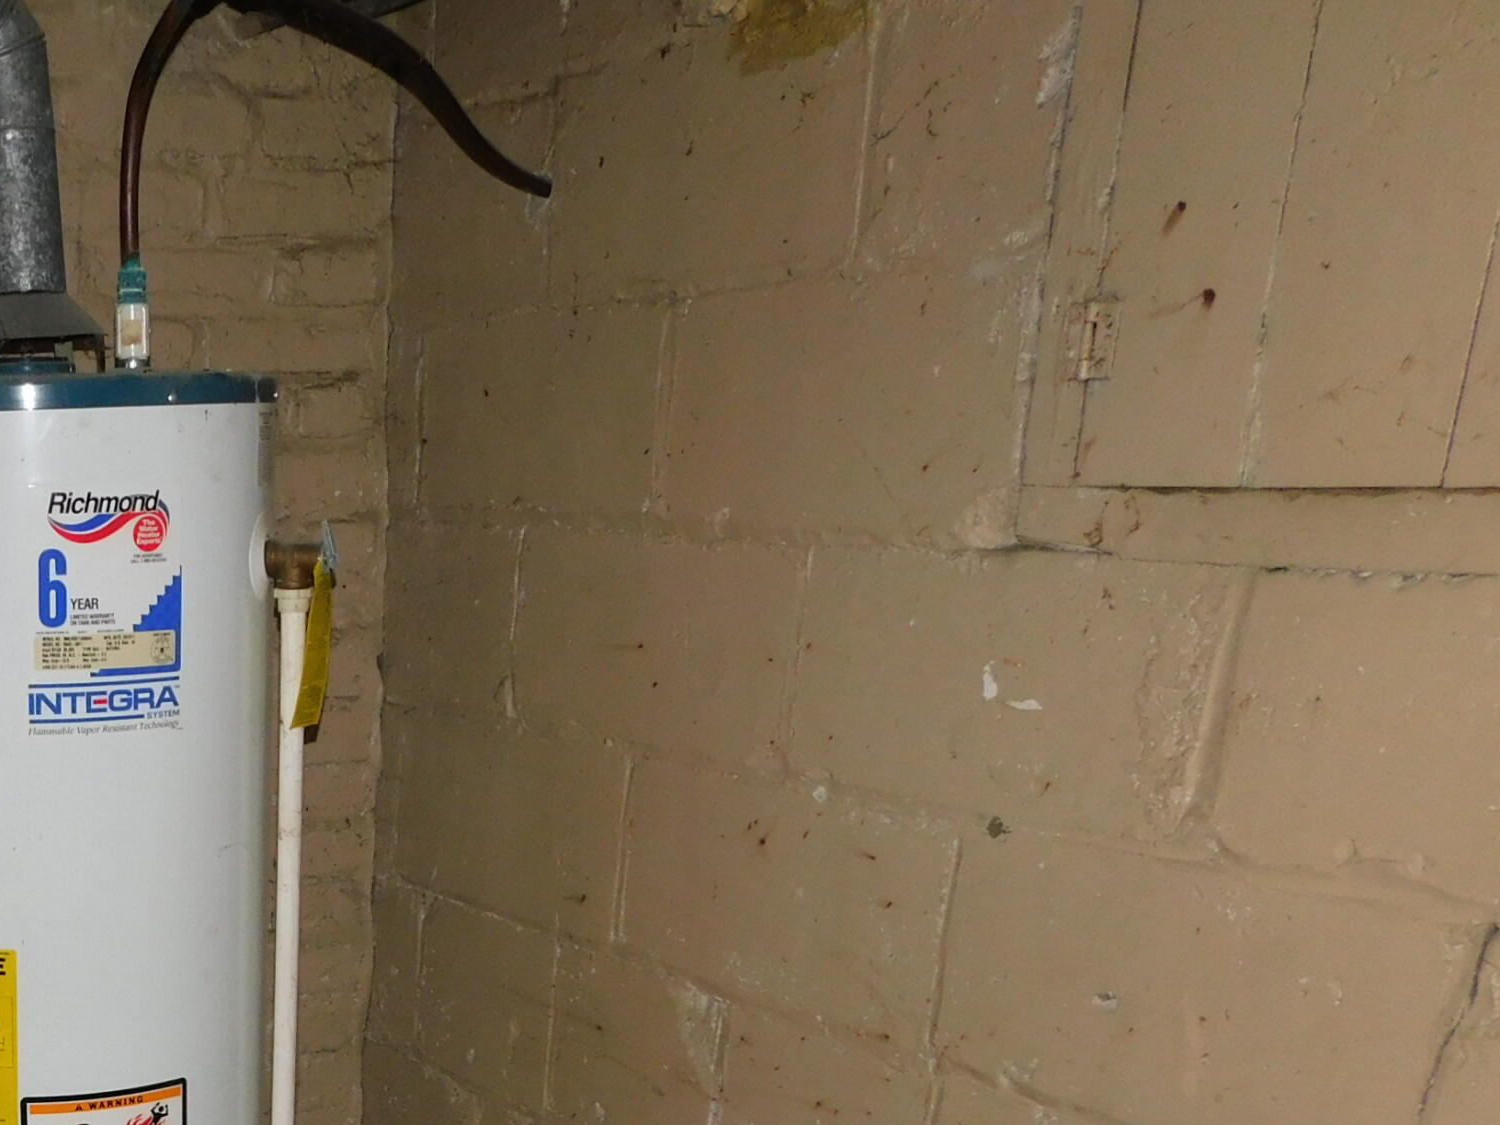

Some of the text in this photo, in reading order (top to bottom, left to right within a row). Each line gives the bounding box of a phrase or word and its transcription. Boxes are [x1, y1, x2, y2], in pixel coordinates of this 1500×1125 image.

[48, 490, 160, 514] Richmond
[38, 548, 68, 628] 6
[70, 598, 100, 611] YEAR
[28, 685, 180, 715] INTEGRA
[145, 709, 180, 720] SYSTEM
[28, 719, 180, 736] Flammable Vapor Resistant Technology
[88, 1095, 144, 1110] WARNING
